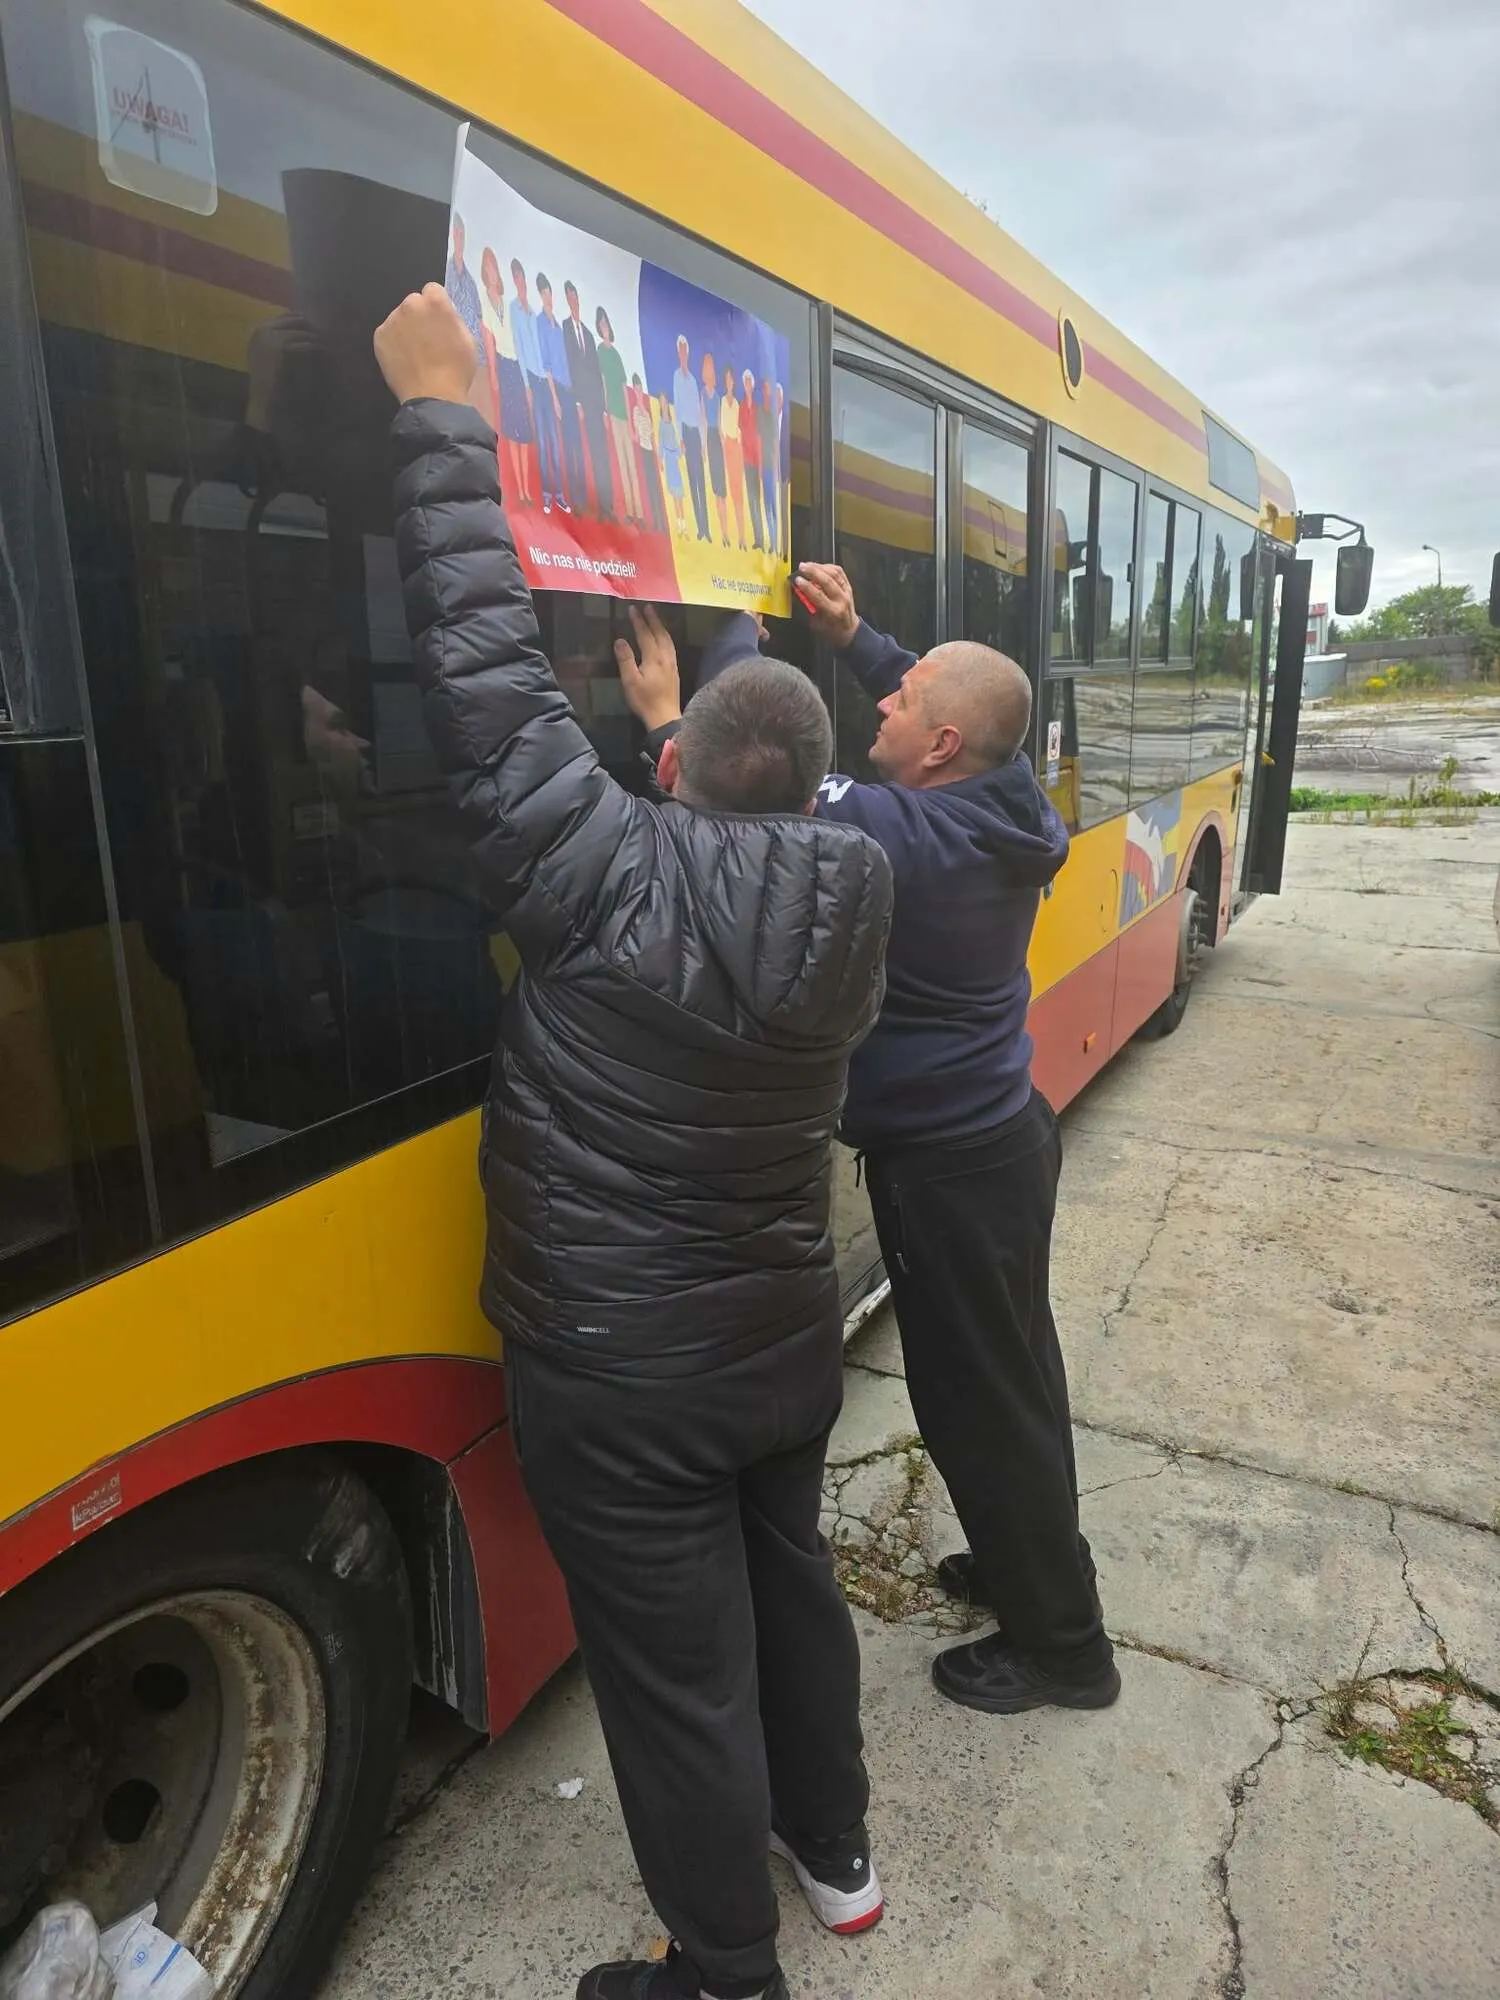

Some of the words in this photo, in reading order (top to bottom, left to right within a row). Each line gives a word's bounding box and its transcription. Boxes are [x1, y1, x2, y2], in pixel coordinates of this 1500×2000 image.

[112, 87, 190, 132] UWAGA!
[528, 546, 551, 566] Nic
[552, 554, 575, 569] nas
[575, 555, 593, 572] nie
[711, 575, 727, 590] Нас
